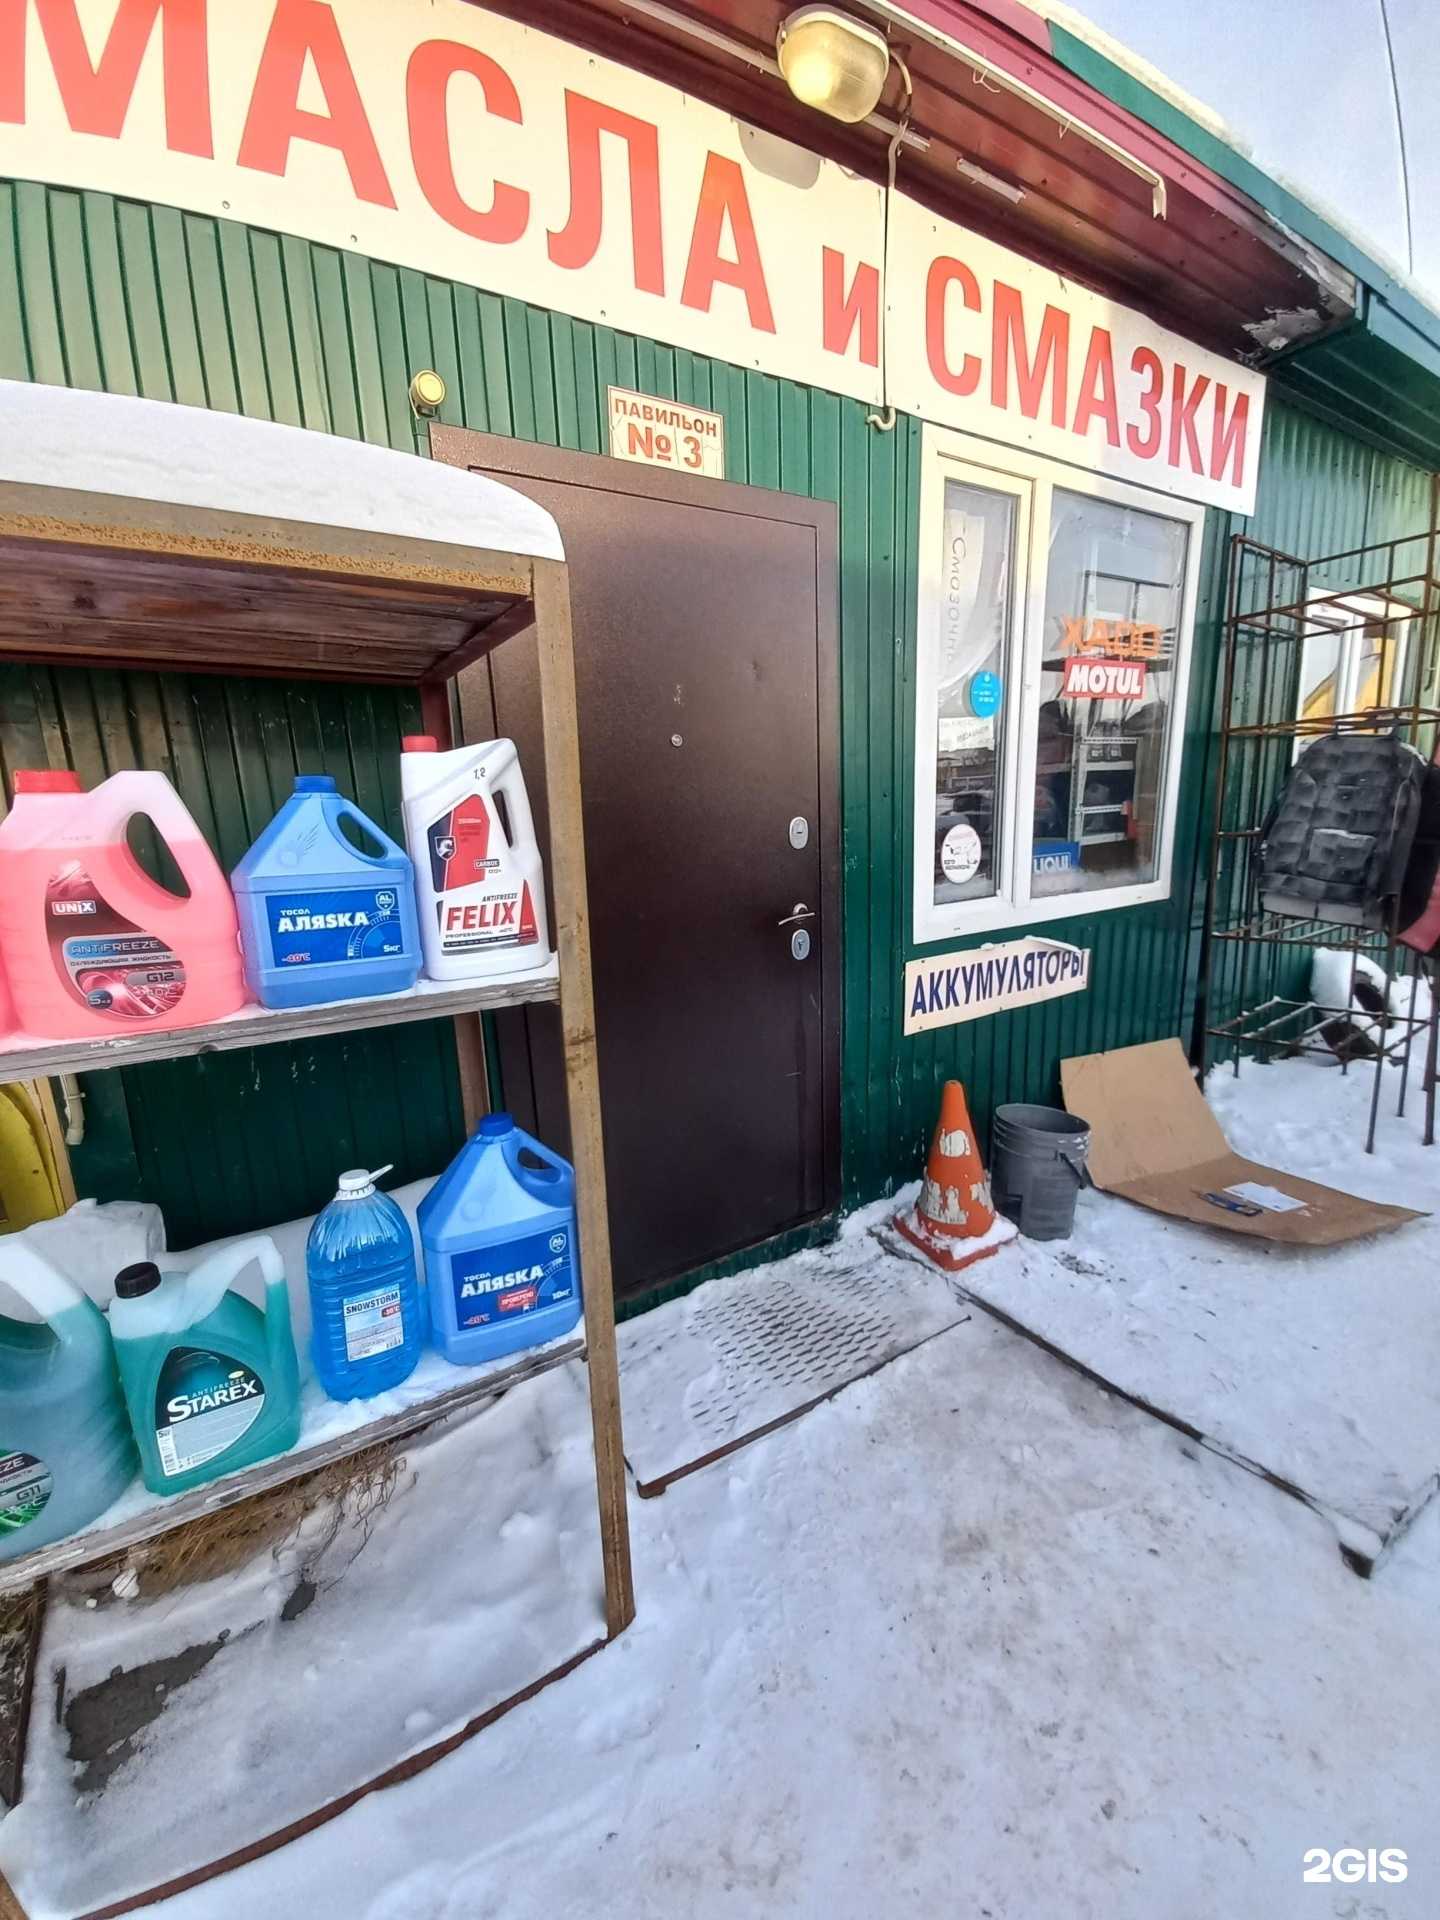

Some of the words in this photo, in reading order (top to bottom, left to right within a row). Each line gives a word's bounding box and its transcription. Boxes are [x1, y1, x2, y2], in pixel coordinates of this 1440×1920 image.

[0, 0, 777, 334] МАСЛА
[821, 245, 879, 367] и
[925, 255, 1251, 488] СМАЗКИ
[614, 398, 717, 437] ПАВИЛЬОН
[683, 435, 702, 468] 3
[1067, 664, 1141, 695] MOTUL
[1033, 855, 1069, 874] LIQUI
[280, 908, 311, 916] ТОСОЛ
[446, 901, 518, 931] FELIX
[71, 940, 160, 954] ANTIFREEZE
[146, 971, 175, 983] G12
[910, 949, 1085, 1017] АККУМУЛЯТОРЫ
[463, 1272, 492, 1282] ТОСОЛ
[346, 1291, 399, 1315] SNOWSTORM
[167, 1379, 258, 1423] STAREX
